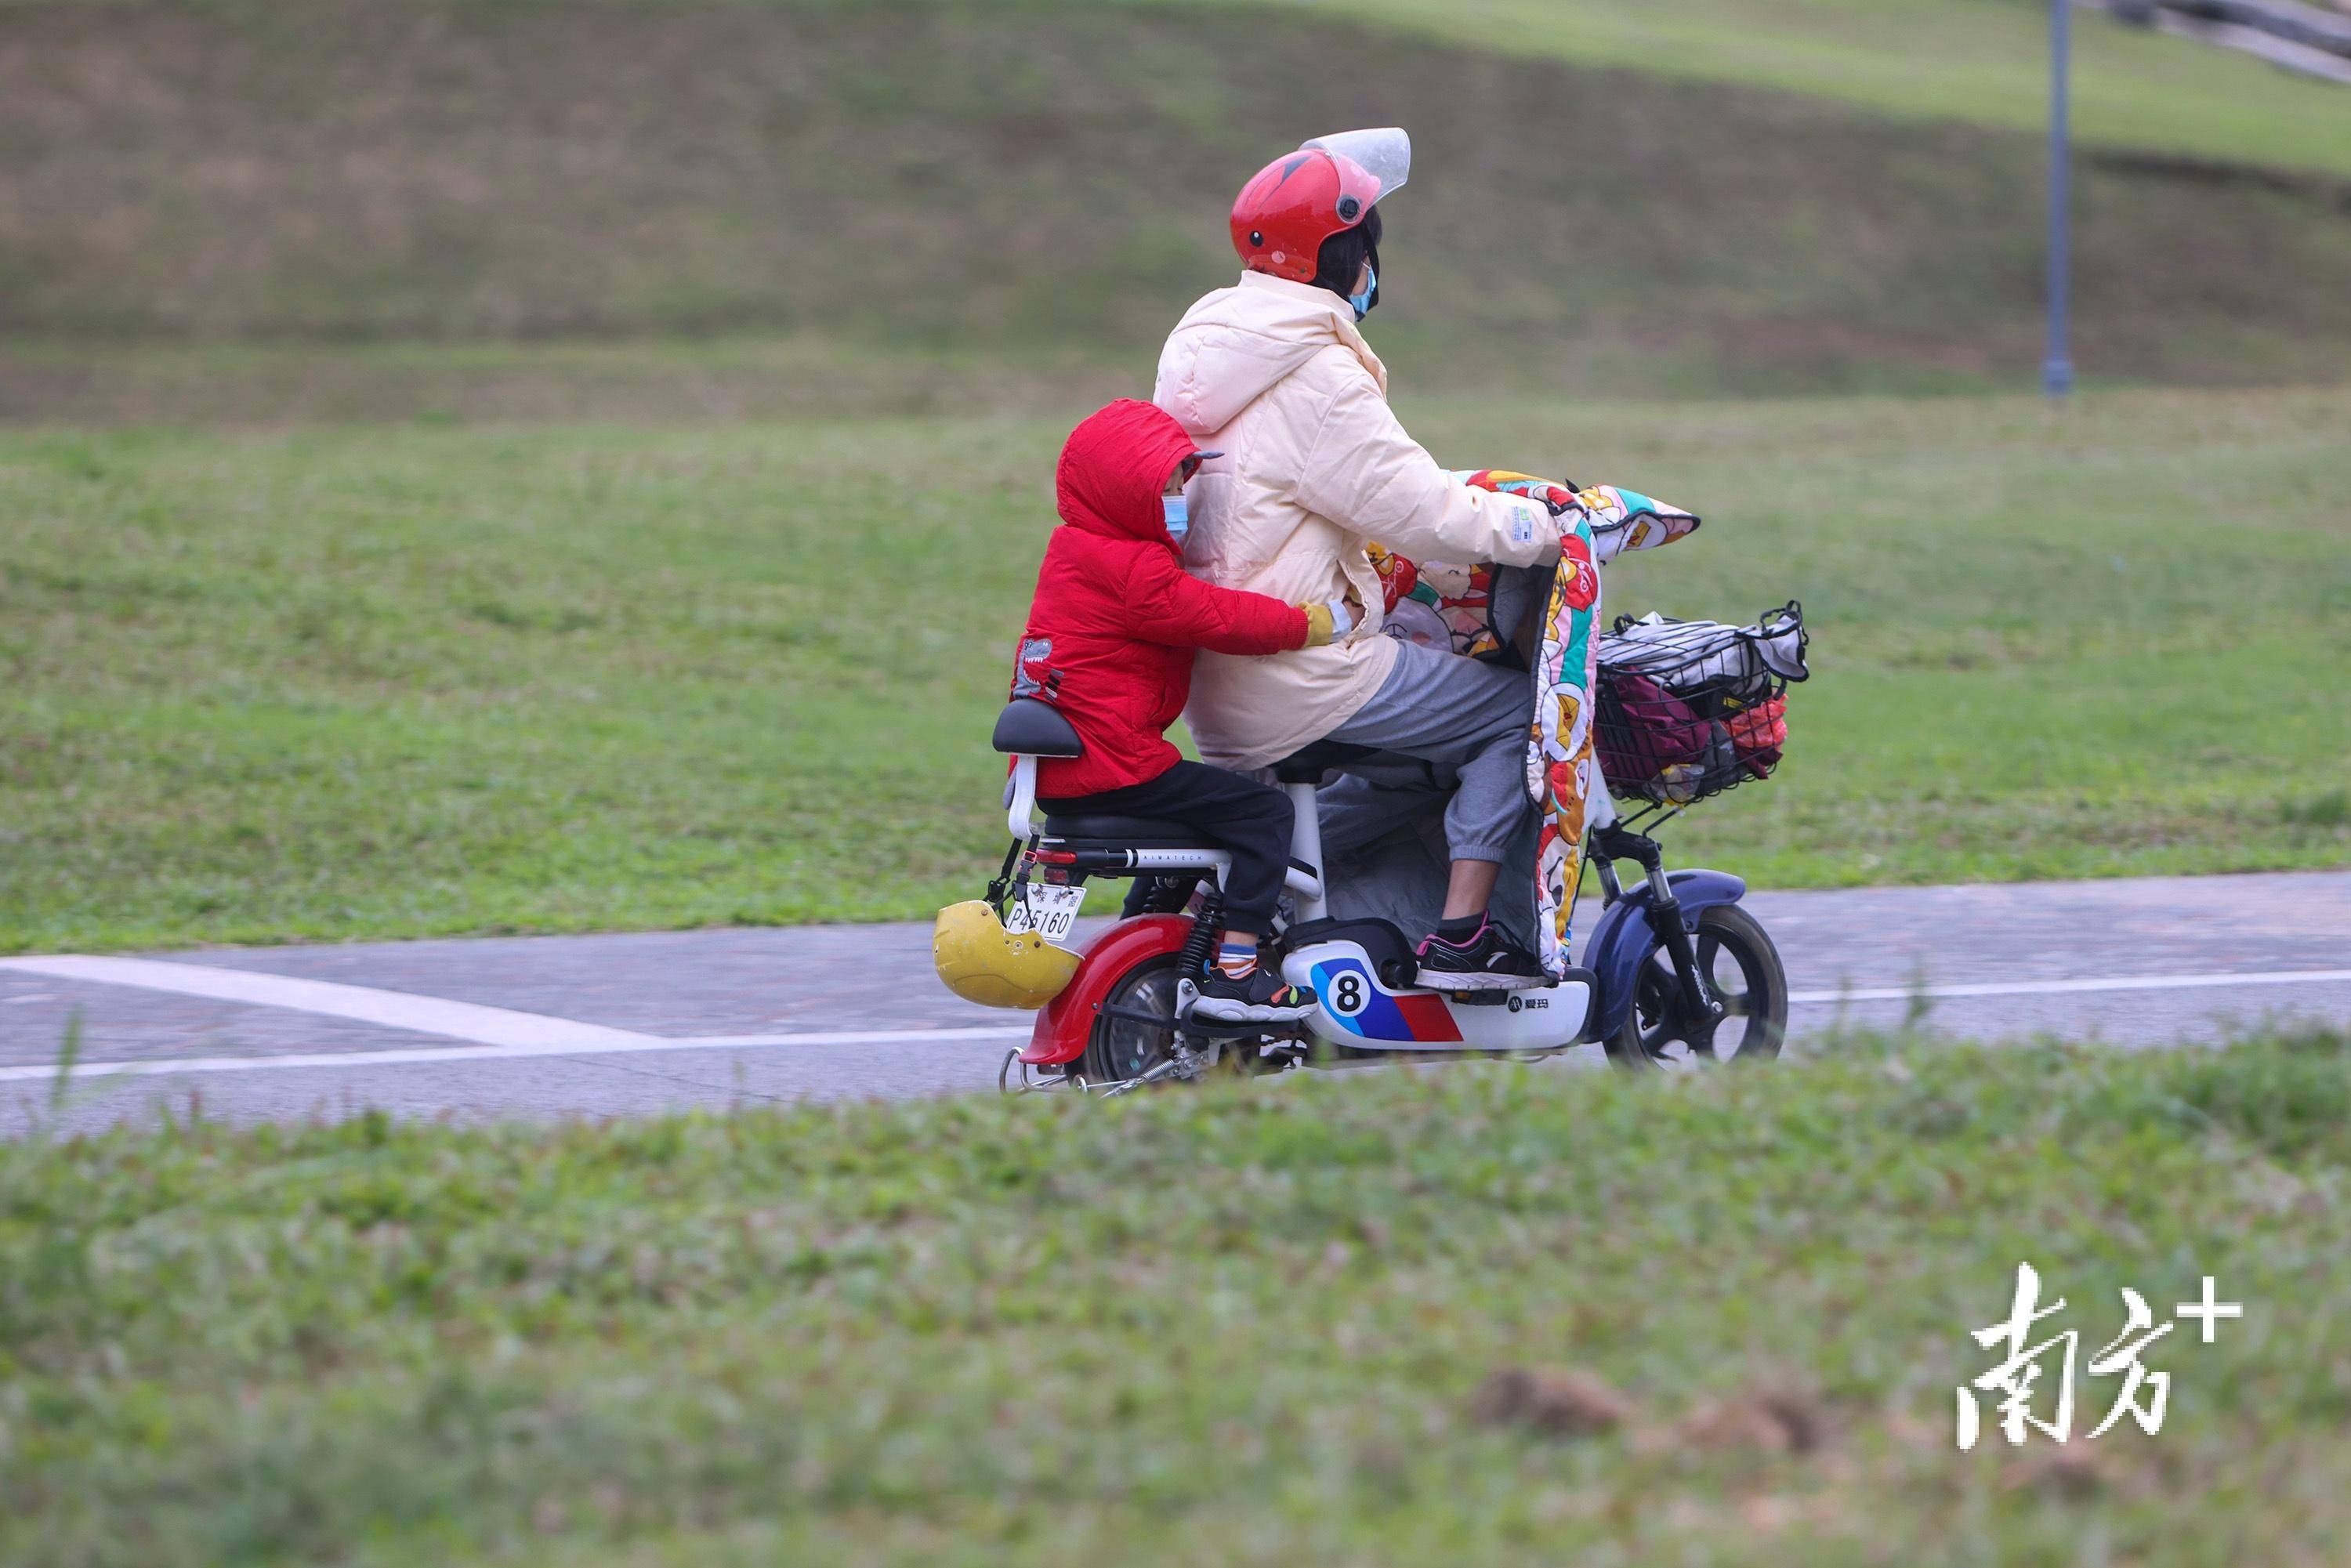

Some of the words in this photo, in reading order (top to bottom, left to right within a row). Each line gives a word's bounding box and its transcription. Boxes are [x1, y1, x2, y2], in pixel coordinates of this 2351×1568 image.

[1009, 908, 1070, 934] P45160
[1337, 975, 1361, 1012] 8
[1525, 998, 1549, 1009] 爱玛
